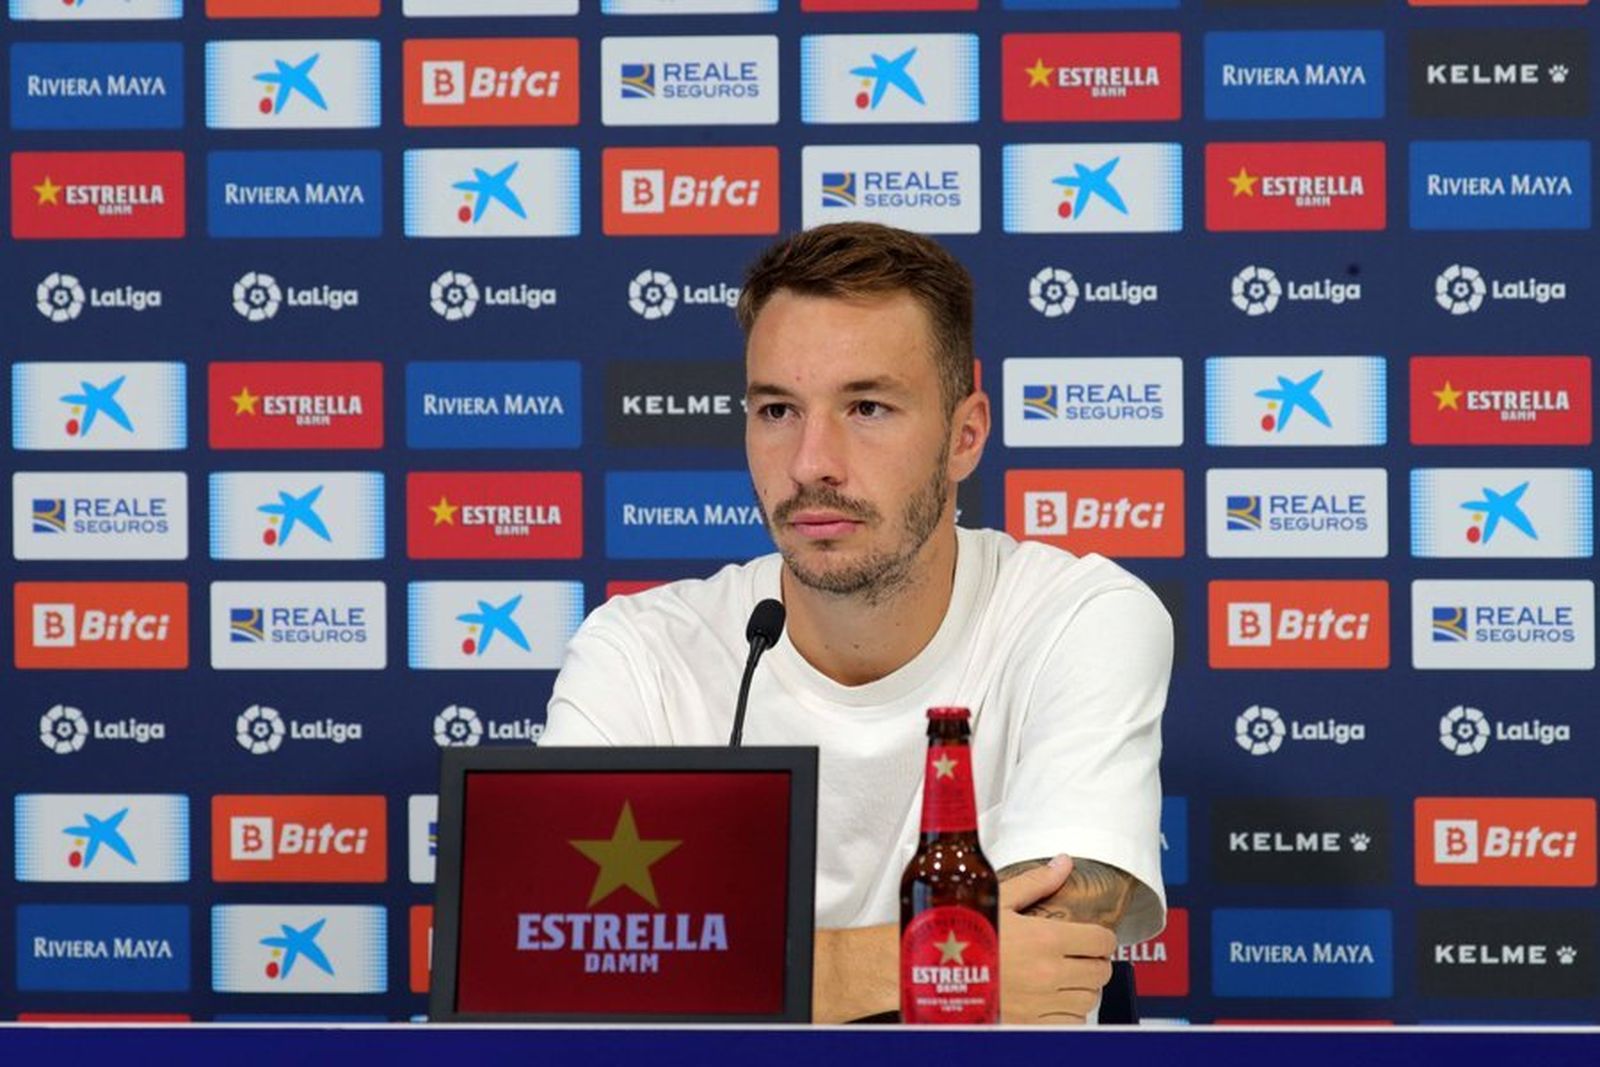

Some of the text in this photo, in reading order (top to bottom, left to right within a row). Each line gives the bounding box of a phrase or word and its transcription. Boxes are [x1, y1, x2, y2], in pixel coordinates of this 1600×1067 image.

[664, 62, 757, 81] REALE
[1059, 67, 1159, 87] ESTRELLA
[1223, 65, 1365, 85] RIVIERA MAYA
[1428, 65, 1538, 83] KELME
[28, 75, 165, 96] RIVIERA MAYA
[470, 67, 560, 97] Bitci
[663, 84, 759, 98] SEGUROS
[670, 176, 760, 206] Bitci
[865, 172, 959, 190] REALE
[1263, 177, 1363, 197] ESTRELLA
[1428, 175, 1572, 195] RIVIERA MAYA
[67, 185, 163, 205] ESTRELLA
[226, 184, 364, 204] RIVIERA MAYA
[865, 193, 961, 207] SEGUROS
[91, 286, 161, 310] LaLiga
[288, 285, 358, 310] LaLiga
[486, 284, 556, 309] LaLiga
[684, 283, 739, 308] LaLig
[1085, 280, 1157, 305] LaLiga
[1288, 279, 1360, 304] LaLiga
[1493, 278, 1565, 303] LaLiga
[1066, 384, 1161, 403] REALE
[1468, 391, 1569, 411] ESTRELLA
[264, 396, 362, 416] ESTRELLA
[424, 394, 563, 414] RIVIERA MAYA
[623, 396, 731, 414] KELME
[1066, 406, 1163, 420] SEGUROS
[74, 499, 166, 517] REALE
[624, 504, 763, 524] RIVIERA MAYA
[1073, 498, 1164, 528] Bitci
[1270, 496, 1365, 514] REALE
[463, 506, 561, 526] ESTRELLA
[1270, 517, 1368, 531] SEGUROS
[74, 520, 168, 533] SEGUROS
[80, 610, 169, 640] Bitci
[272, 608, 365, 626] REALE
[1278, 609, 1369, 639] Bitci
[1476, 607, 1572, 625] REALE
[272, 629, 367, 643] SEGUROS
[1476, 629, 1575, 642] SEGUROS
[95, 718, 164, 742] LaLiga
[291, 719, 361, 743] LaLiga
[488, 719, 544, 743] LaLig
[1292, 719, 1364, 744] LaLiga
[1497, 720, 1570, 744] LaLiga
[278, 823, 368, 853] Bitci
[1230, 833, 1340, 851] KELME
[1485, 827, 1576, 857] Bitci
[517, 914, 727, 951] ESTRELLA
[34, 937, 172, 958] RIVIERA MAYA
[1231, 942, 1374, 963] RIVIERA MAYA
[1436, 945, 1546, 964] KELME
[585, 954, 658, 972] DAMM
[912, 966, 990, 984] ESTRELLA
